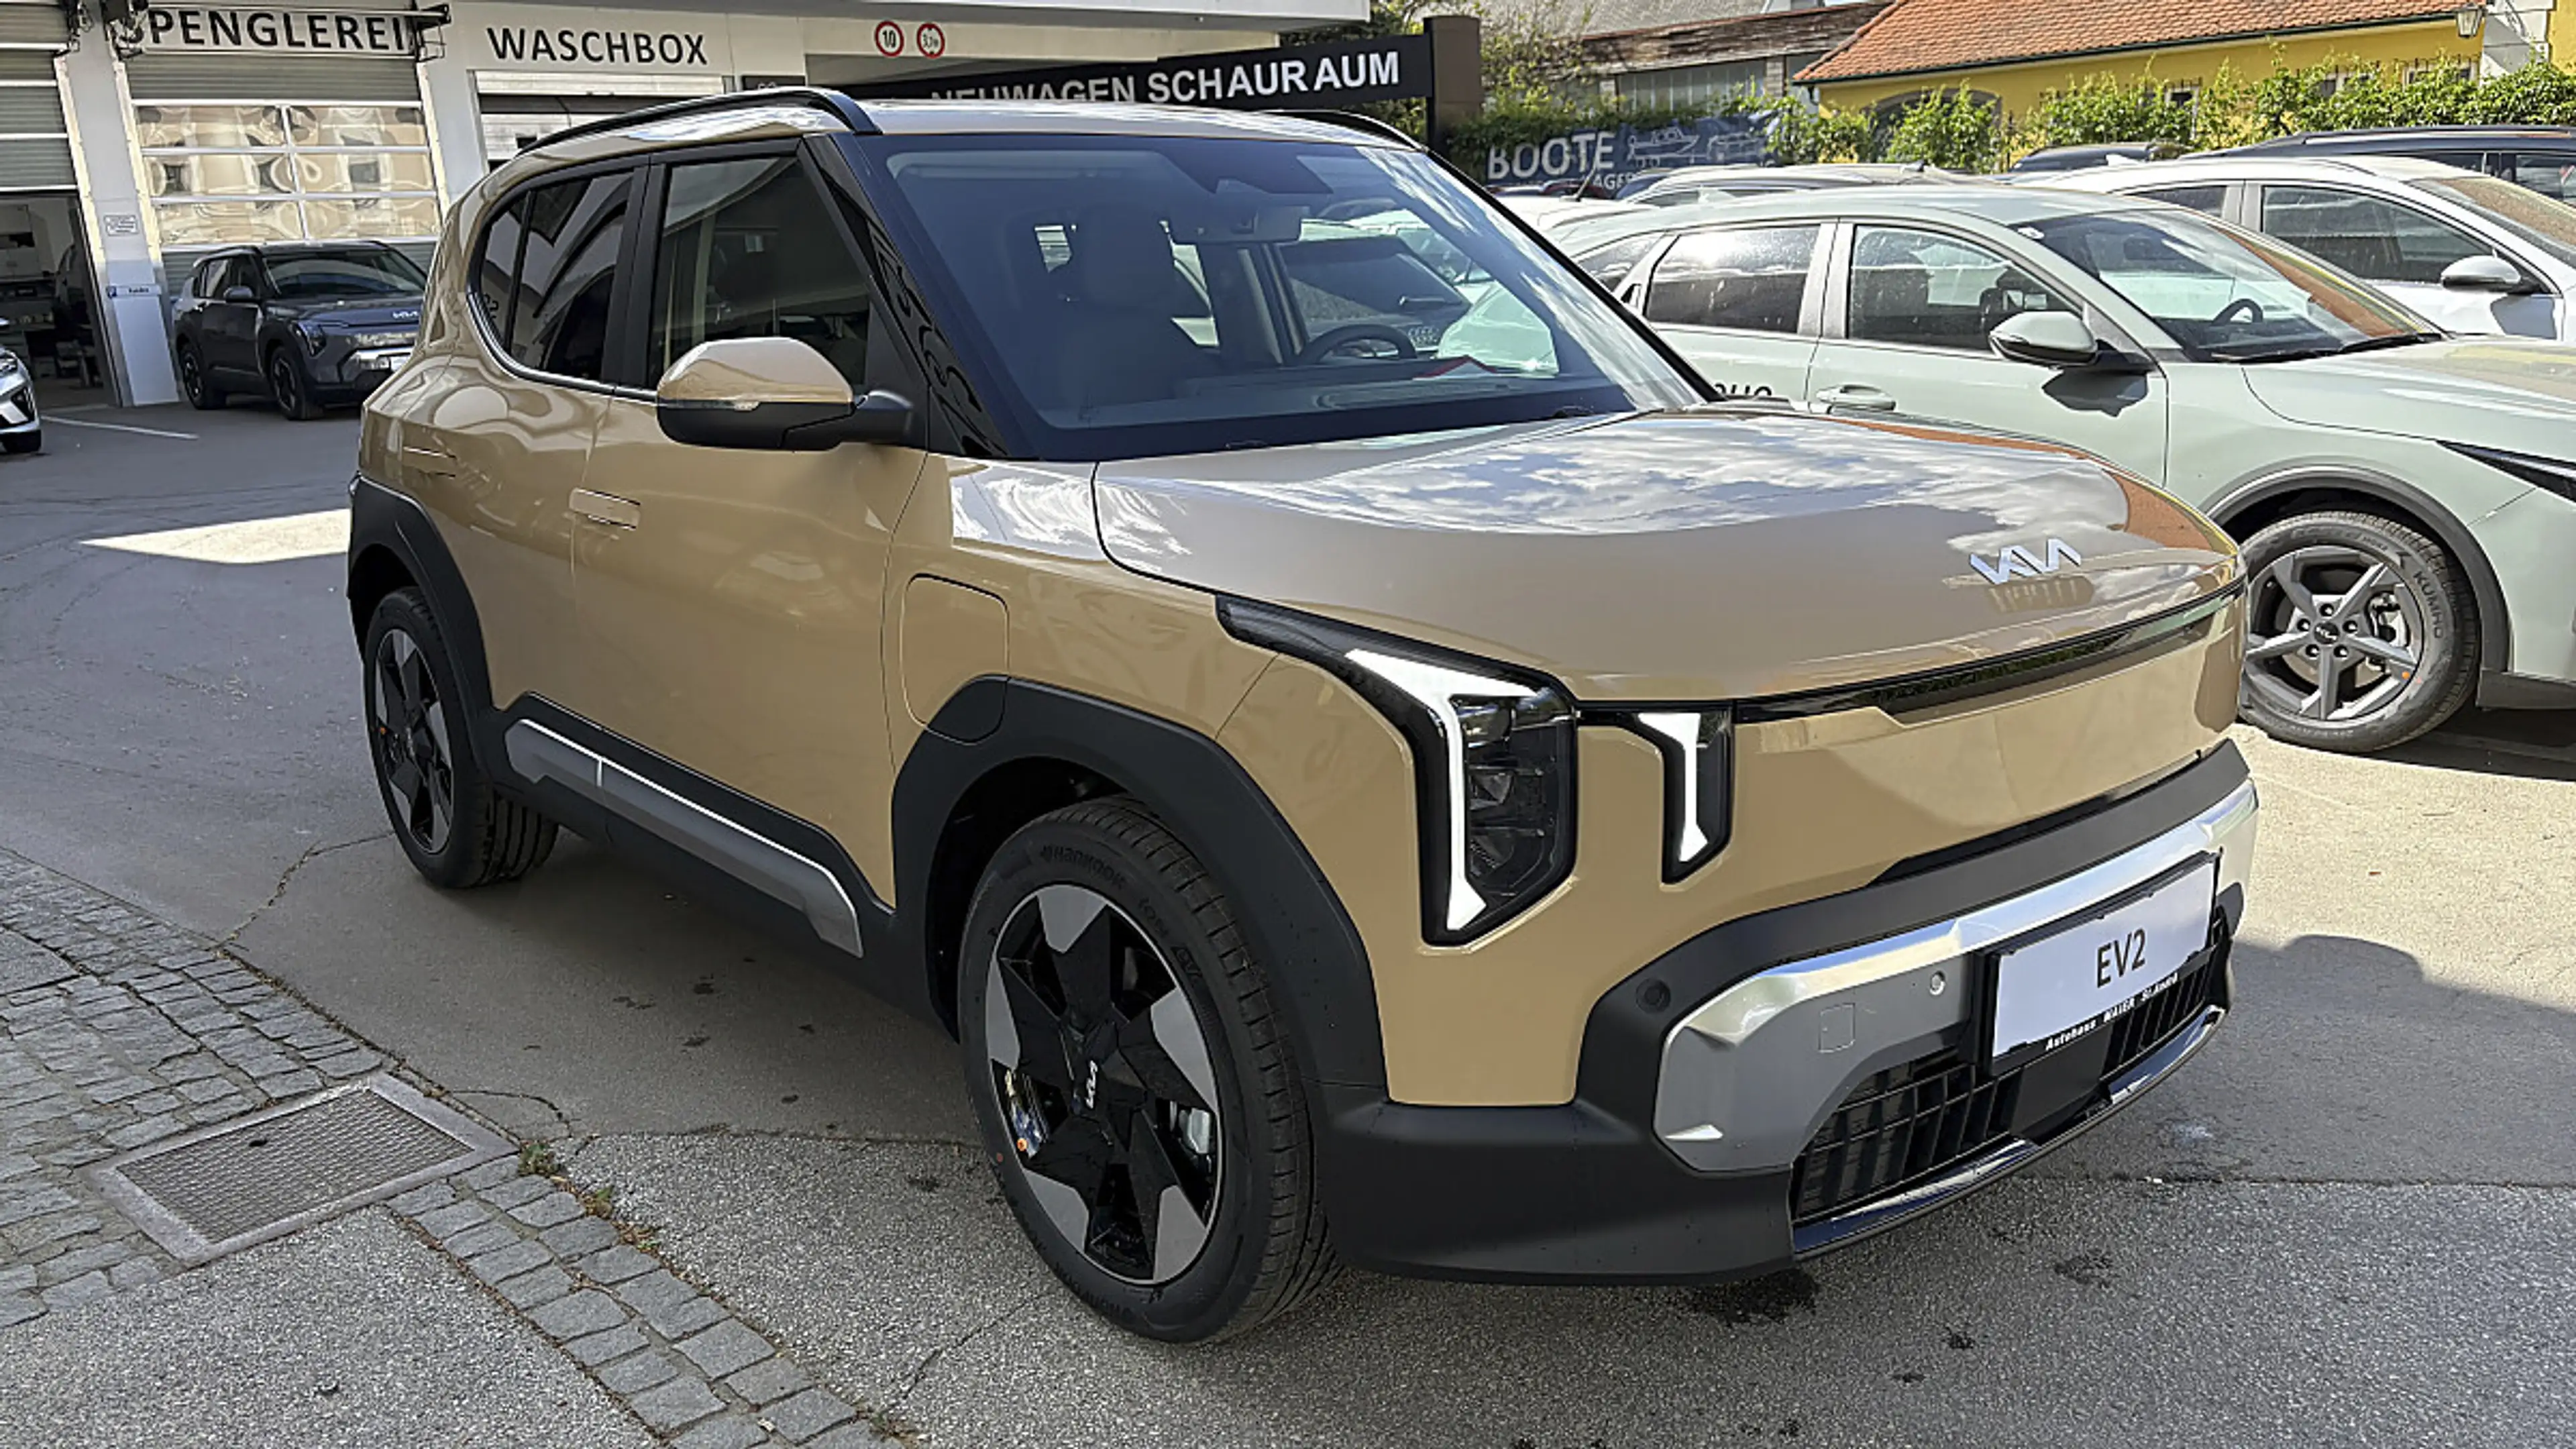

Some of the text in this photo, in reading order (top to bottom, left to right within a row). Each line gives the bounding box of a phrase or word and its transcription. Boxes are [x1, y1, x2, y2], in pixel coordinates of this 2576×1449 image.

[487, 28, 708, 65] WASCHBOX
[882, 30, 896, 48] 10
[931, 51, 1399, 103] WAGEN SCHAURAUM
[1488, 132, 1616, 180] BOOTE
[1970, 539, 2082, 584] KIA
[2097, 928, 2146, 988] EV2
